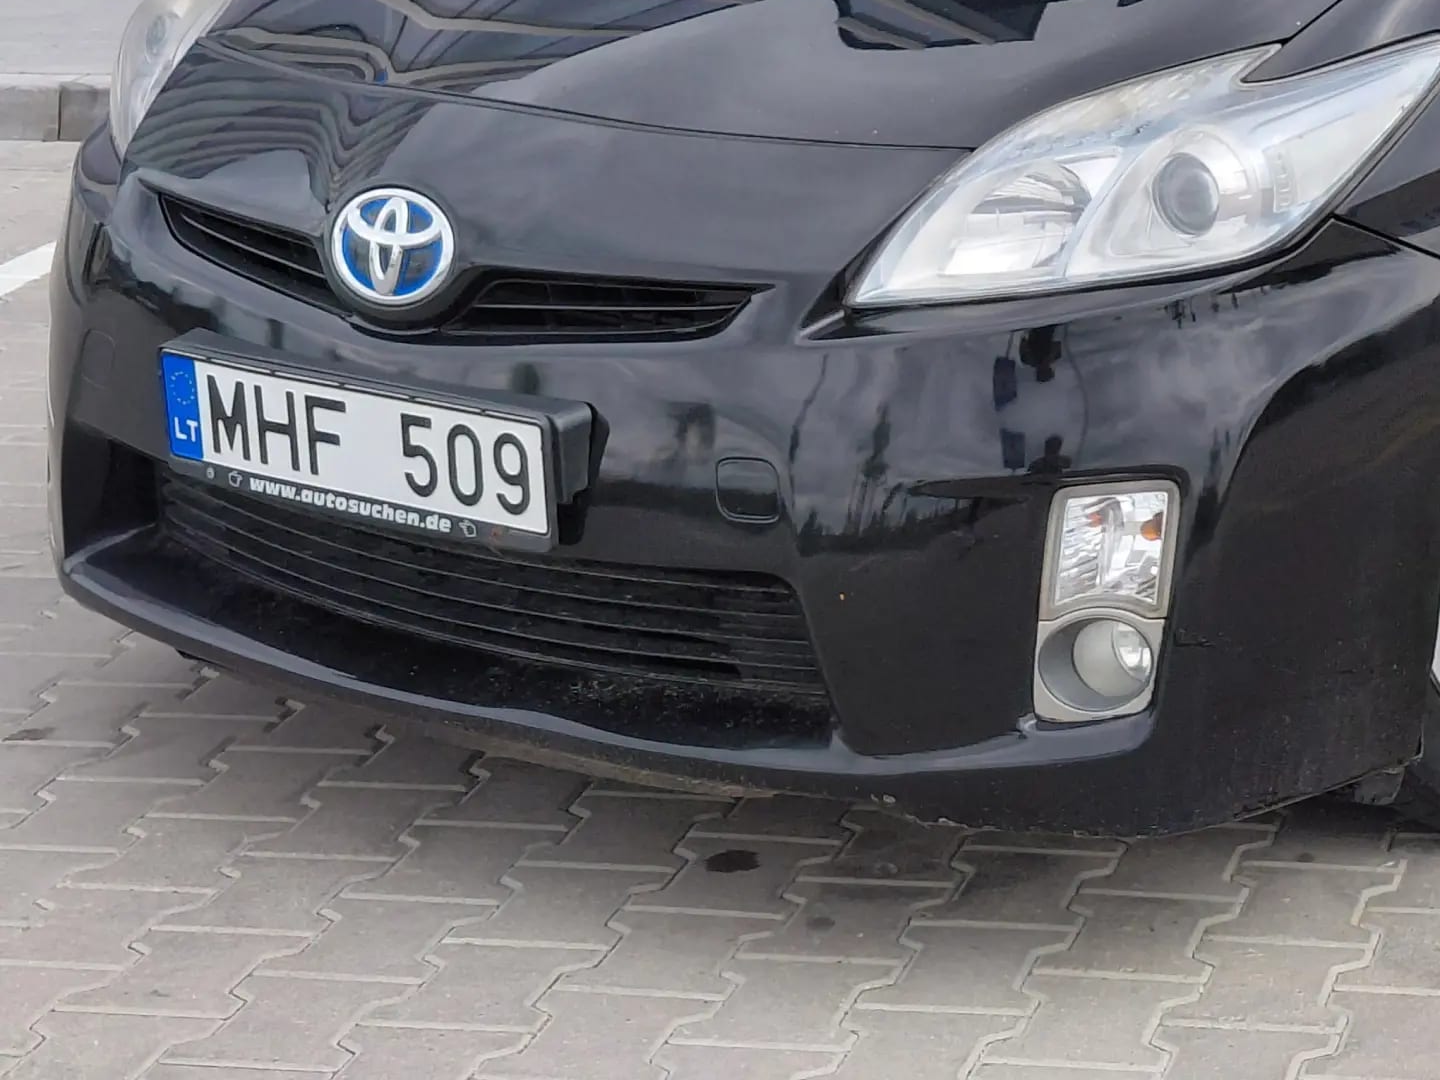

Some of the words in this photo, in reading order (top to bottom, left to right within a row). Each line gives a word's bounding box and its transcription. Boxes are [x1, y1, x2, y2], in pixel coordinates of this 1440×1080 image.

[174, 416, 199, 443] LT
[206, 373, 347, 476] MHF
[400, 412, 530, 516] 509
[249, 477, 452, 533] www.autosuchen.de
